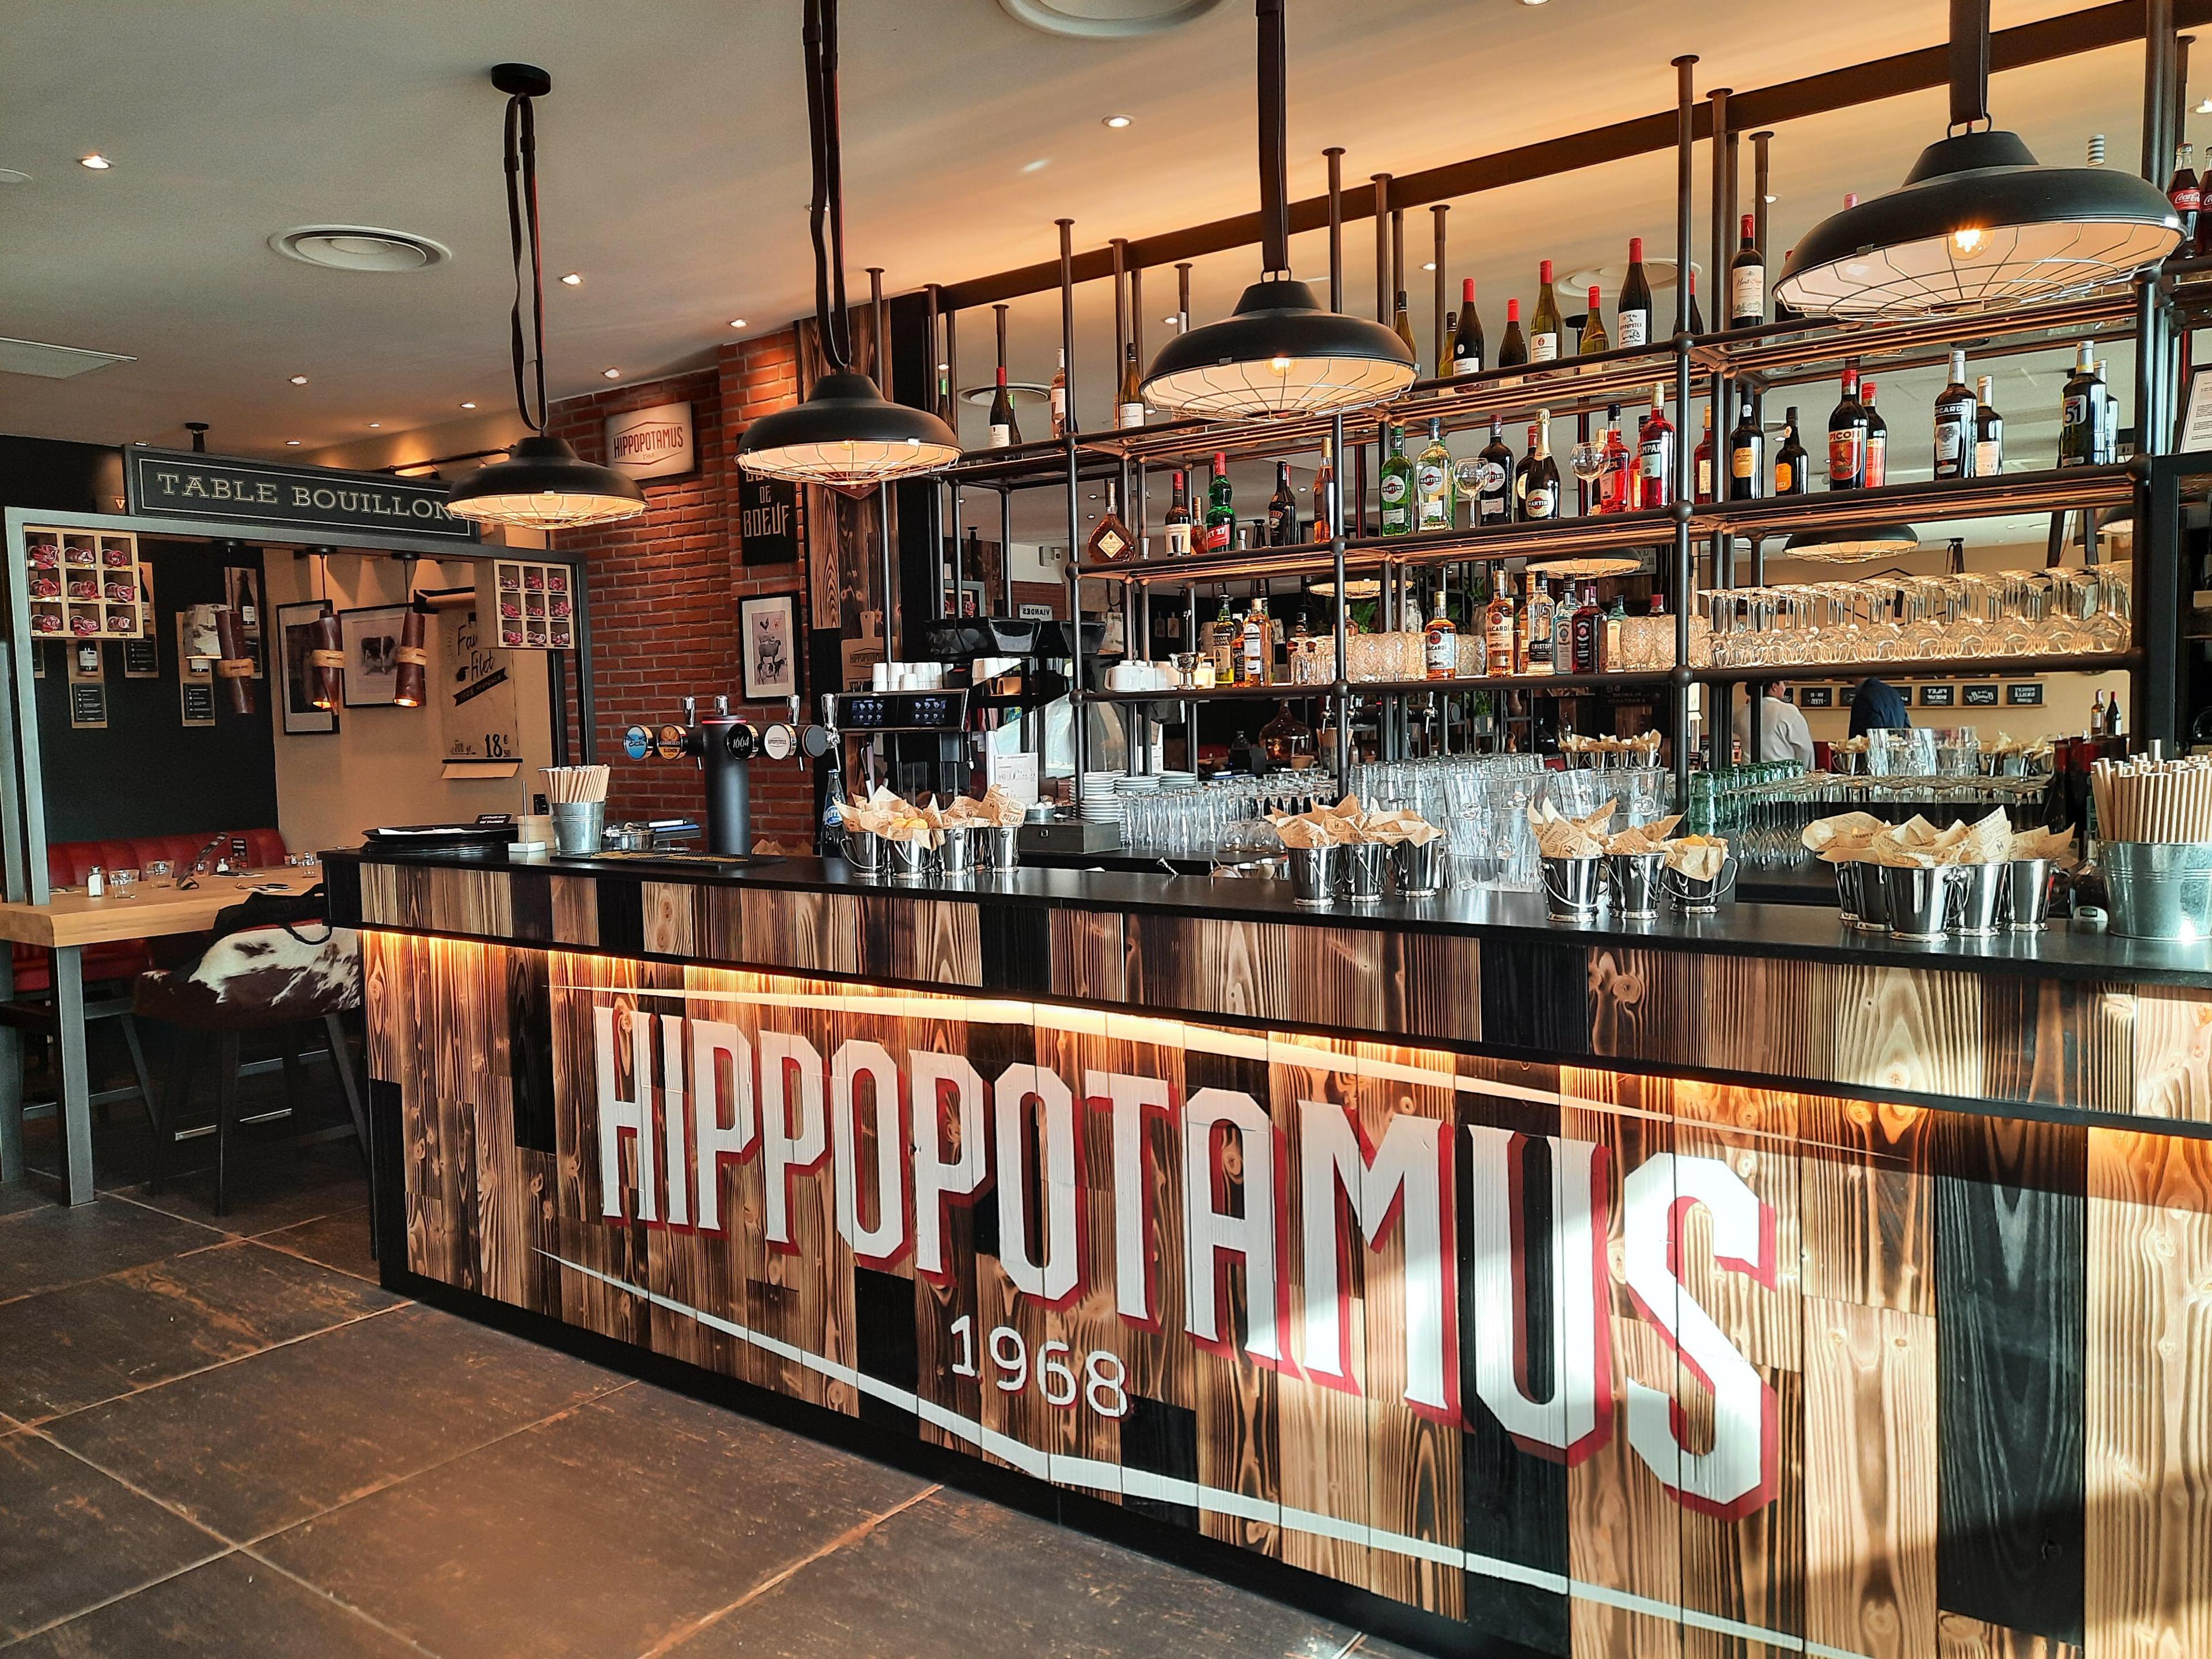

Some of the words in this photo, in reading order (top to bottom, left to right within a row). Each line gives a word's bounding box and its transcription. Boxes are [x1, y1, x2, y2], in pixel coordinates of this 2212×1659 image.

[2065, 404, 2081, 424] 51
[613, 426, 684, 459] HIPPOPOTAMUS
[1383, 485, 1403, 493] MARTINI
[1419, 476, 1442, 484] MARTINI
[156, 472, 278, 505] TABLE
[290, 485, 453, 521] BOUILLON
[759, 485, 771, 503] DE
[743, 501, 790, 537] BOEUF
[1215, 527, 1226, 535] 27
[457, 624, 478, 656] Fau
[471, 649, 495, 681] Filet
[849, 652, 885, 663] HIPPOPOTAMU
[484, 733, 503, 757] 18
[733, 736, 749, 748] 1664
[593, 1006, 1771, 1515] HIPPOPOTAMUS
[950, 1314, 1127, 1419] 1968
